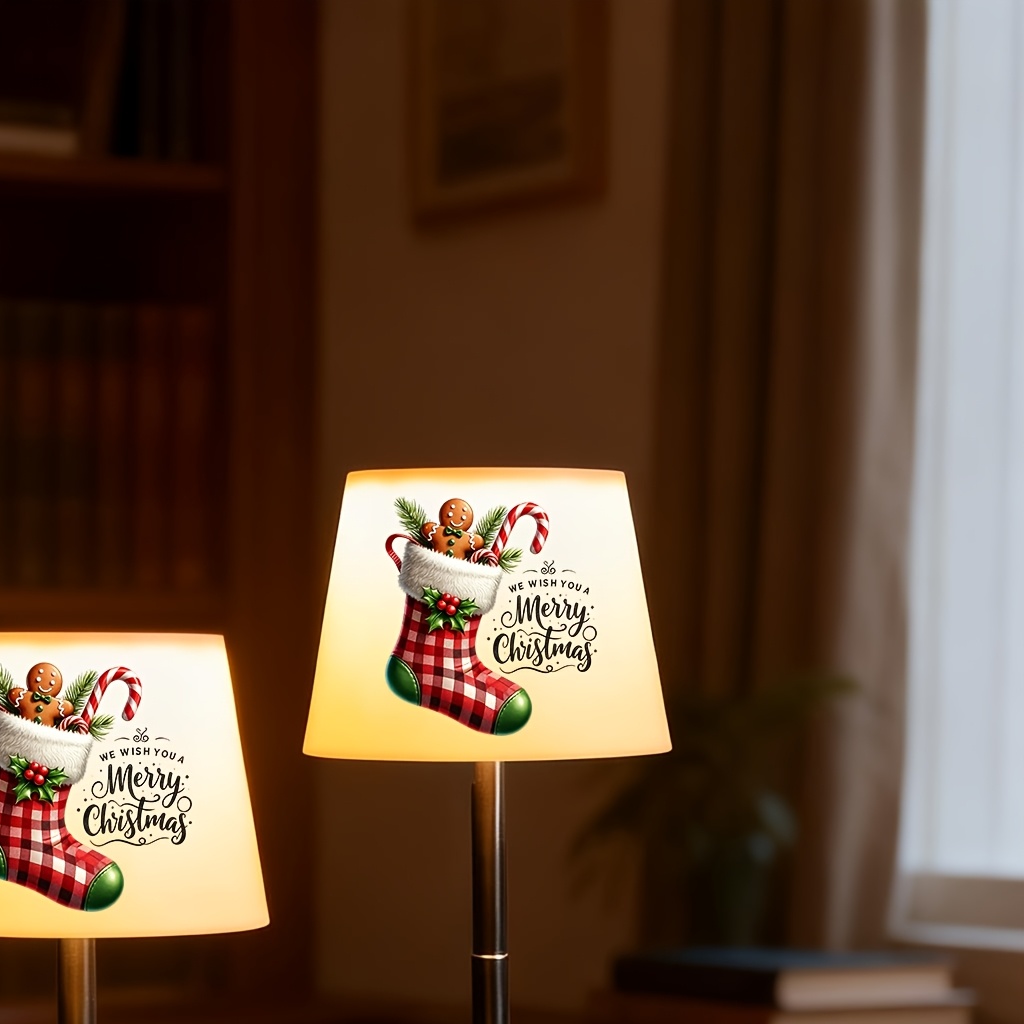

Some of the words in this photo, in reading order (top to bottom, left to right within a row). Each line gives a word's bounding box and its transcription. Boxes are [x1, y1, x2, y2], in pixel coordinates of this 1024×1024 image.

[508, 582, 525, 593] WE
[528, 579, 557, 588] WISH
[560, 580, 582, 592] YOU
[583, 587, 590, 595] A
[500, 594, 591, 638] Merry
[492, 625, 593, 673] Christmas
[99, 750, 116, 762] WE
[119, 747, 150, 757] WISH
[154, 747, 177, 760] YOU
[177, 755, 185, 764] A
[91, 763, 185, 809] Merry
[82, 796, 188, 845] Christmas
